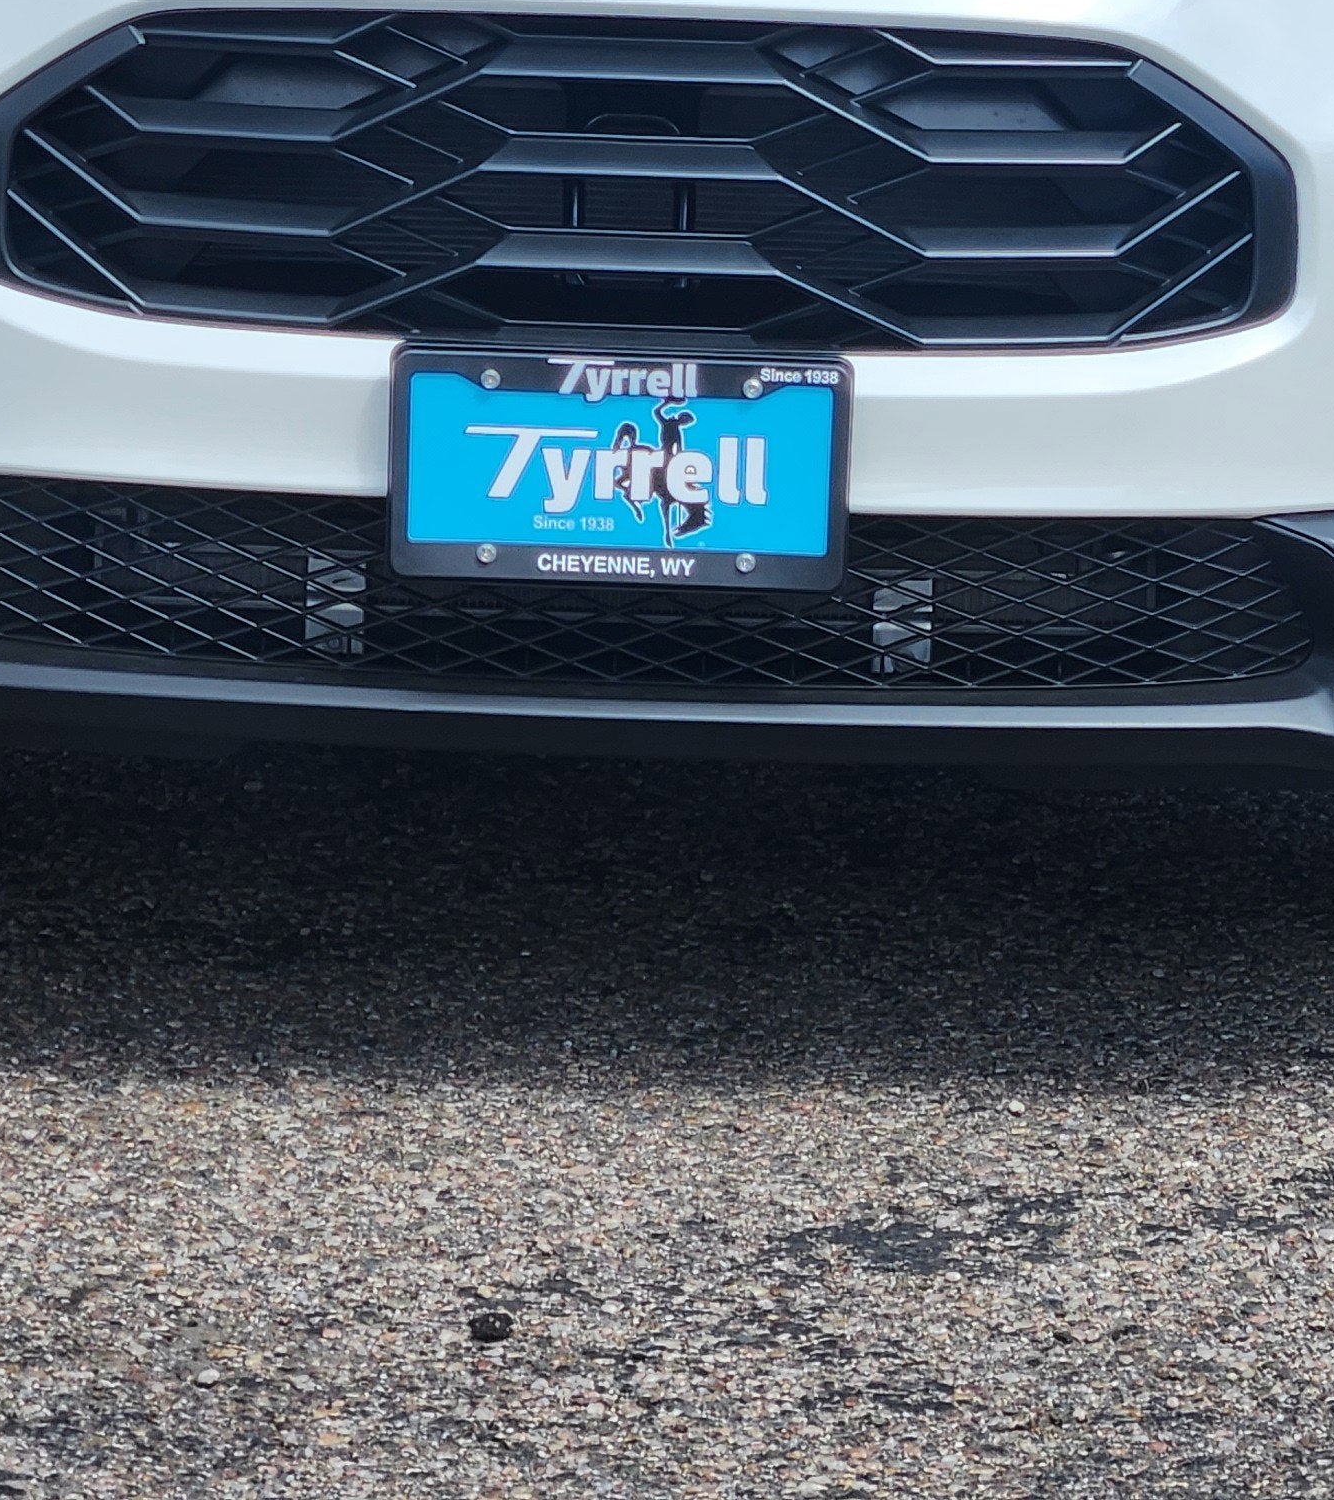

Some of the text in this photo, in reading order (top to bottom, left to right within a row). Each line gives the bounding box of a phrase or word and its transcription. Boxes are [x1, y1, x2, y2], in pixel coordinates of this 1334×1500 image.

[547, 358, 697, 402] Tyrrell
[760, 367, 839, 385] Since 1938
[465, 425, 768, 513] Tyrrell
[533, 514, 615, 531] Since 1938
[537, 553, 695, 578] CHEYENNE, WY
